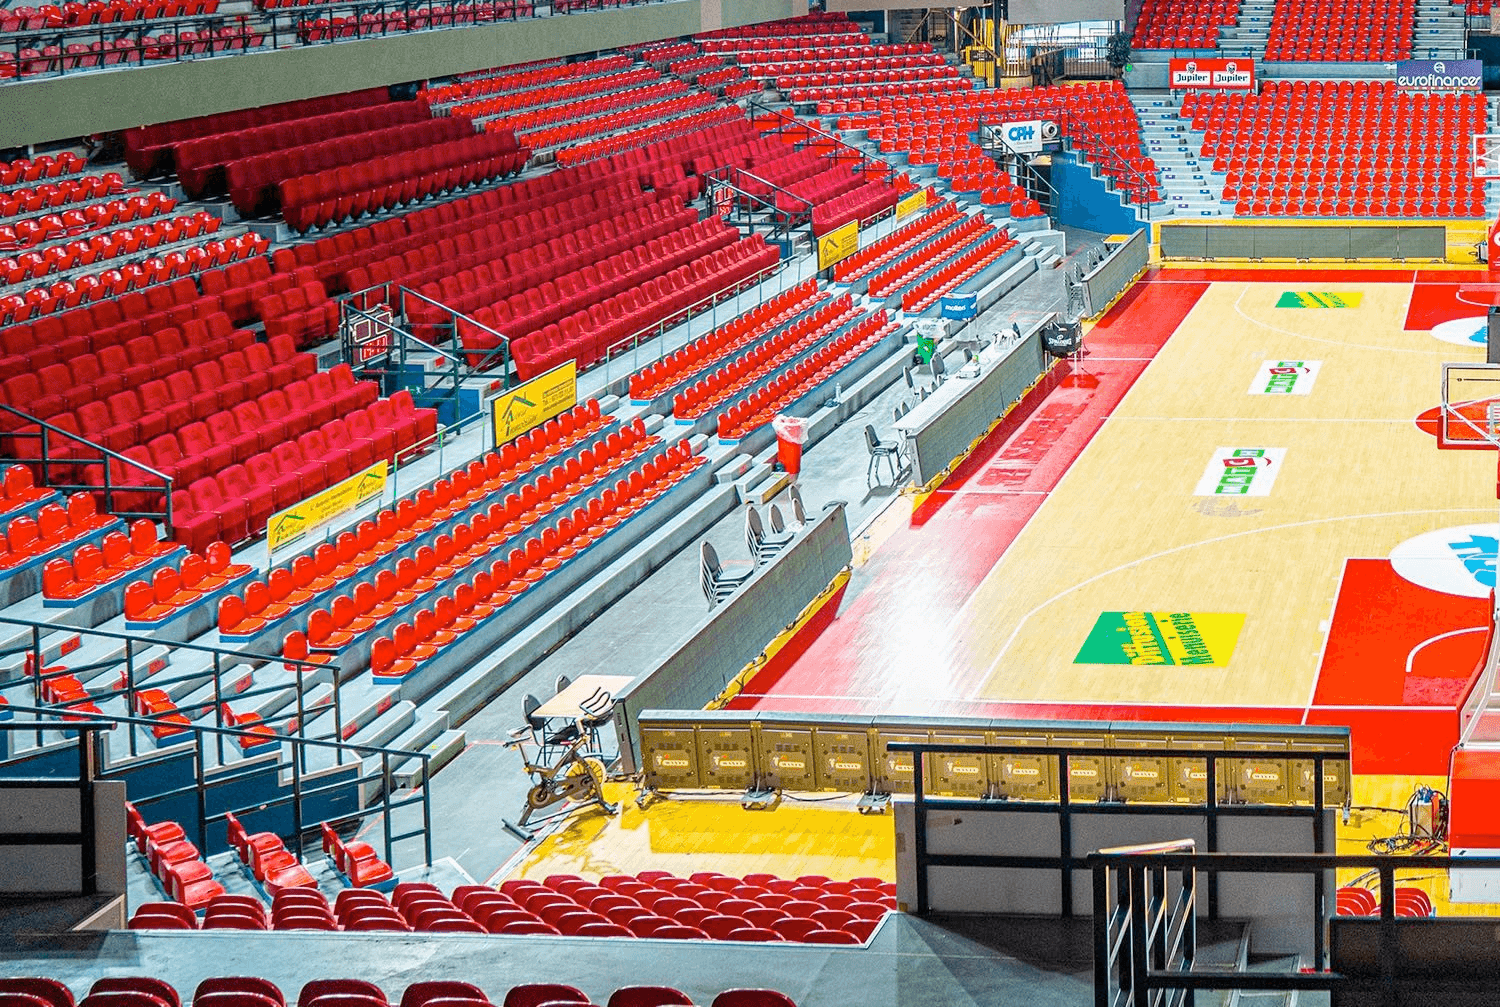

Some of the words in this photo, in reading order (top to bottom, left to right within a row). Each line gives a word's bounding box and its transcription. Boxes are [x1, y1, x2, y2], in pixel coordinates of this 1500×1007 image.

[1176, 73, 1207, 83] Jupiler
[1216, 73, 1248, 83] Jupiler
[1008, 125, 1035, 142] CPH
